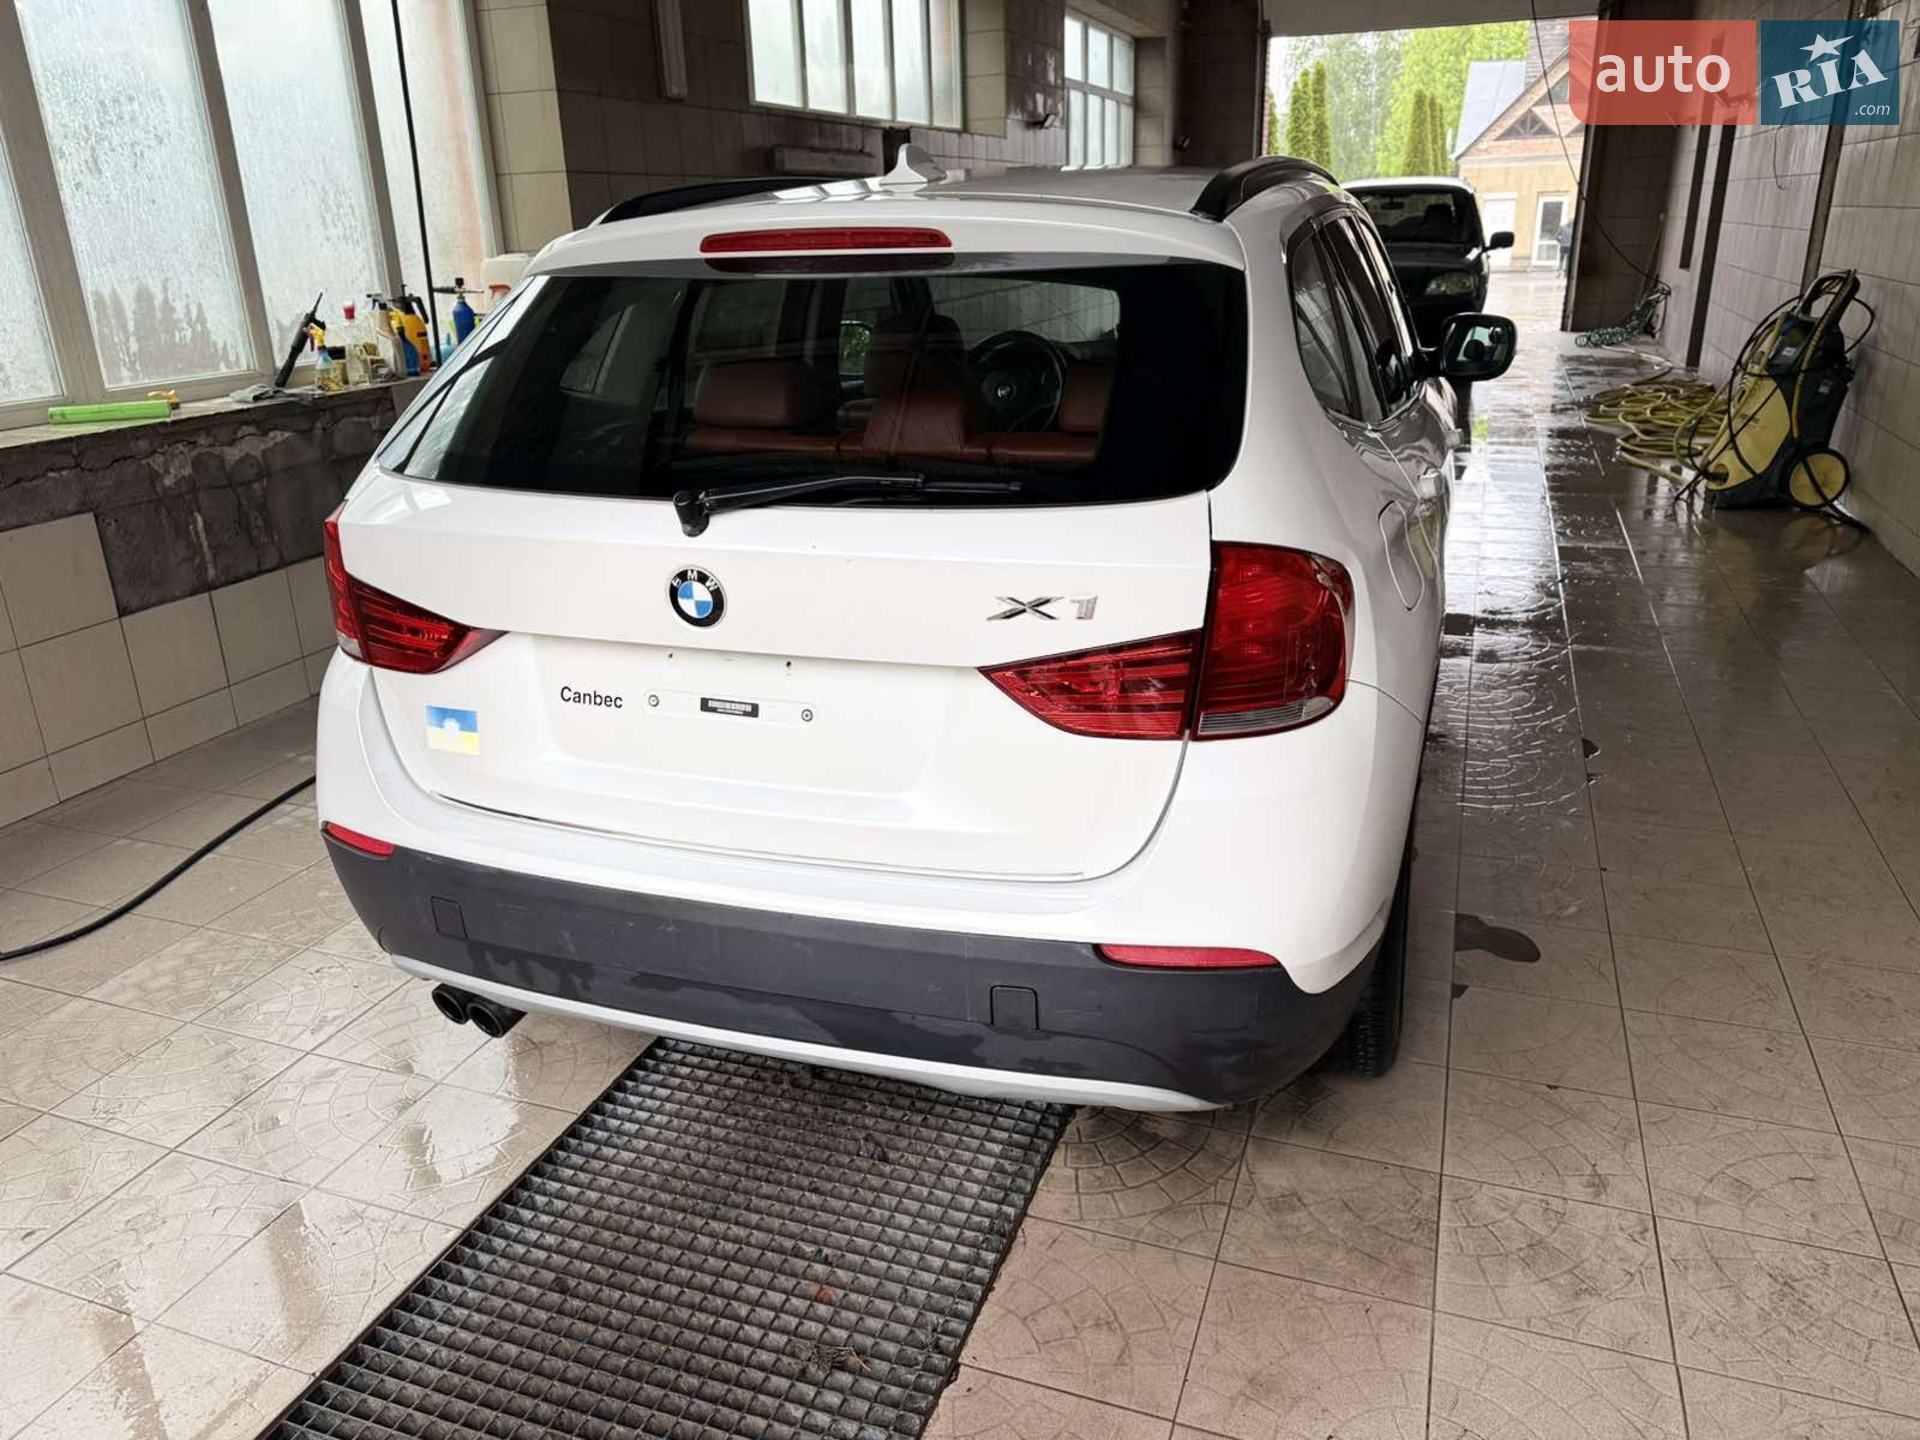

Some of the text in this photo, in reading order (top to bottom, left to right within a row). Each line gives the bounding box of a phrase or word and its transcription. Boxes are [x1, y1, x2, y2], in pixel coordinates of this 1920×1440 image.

[671, 568, 719, 591] BMW
[986, 594, 1098, 620] X1
[560, 685, 623, 709] Canbec
